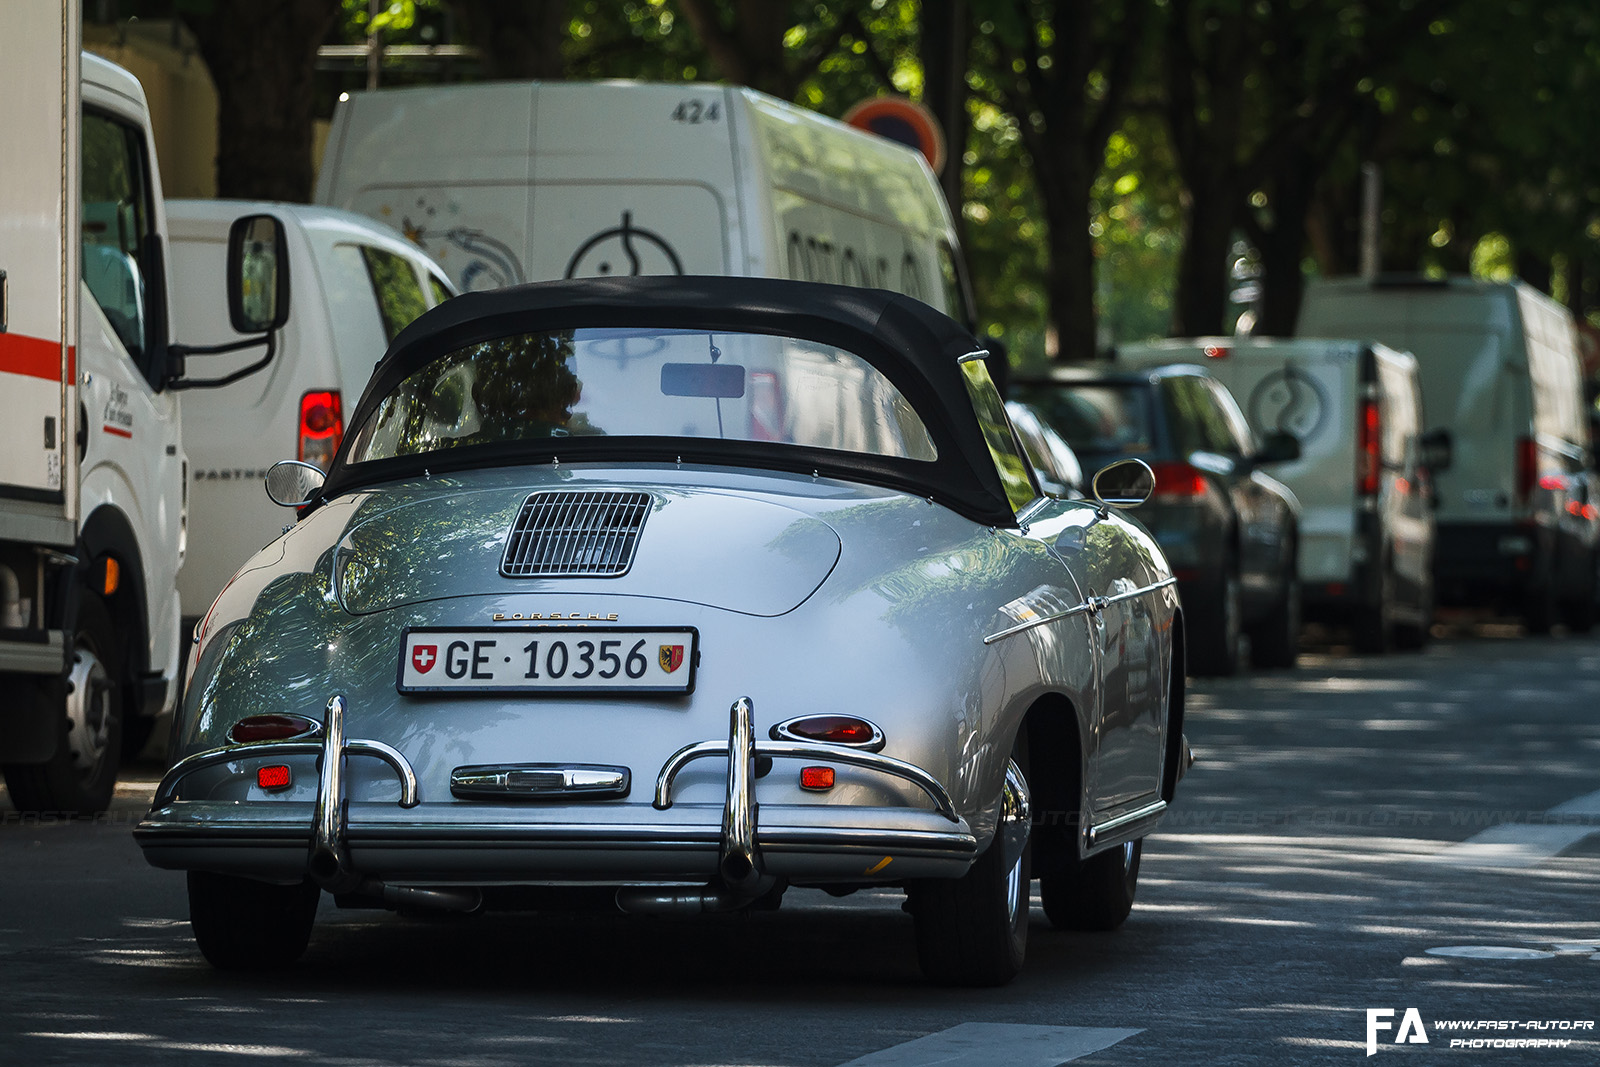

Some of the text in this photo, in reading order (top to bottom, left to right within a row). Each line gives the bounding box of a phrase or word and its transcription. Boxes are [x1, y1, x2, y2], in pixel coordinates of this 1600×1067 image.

[670, 99, 721, 124] 424
[493, 612, 619, 622] PORSCHE
[523, 638, 648, 680] 10356
